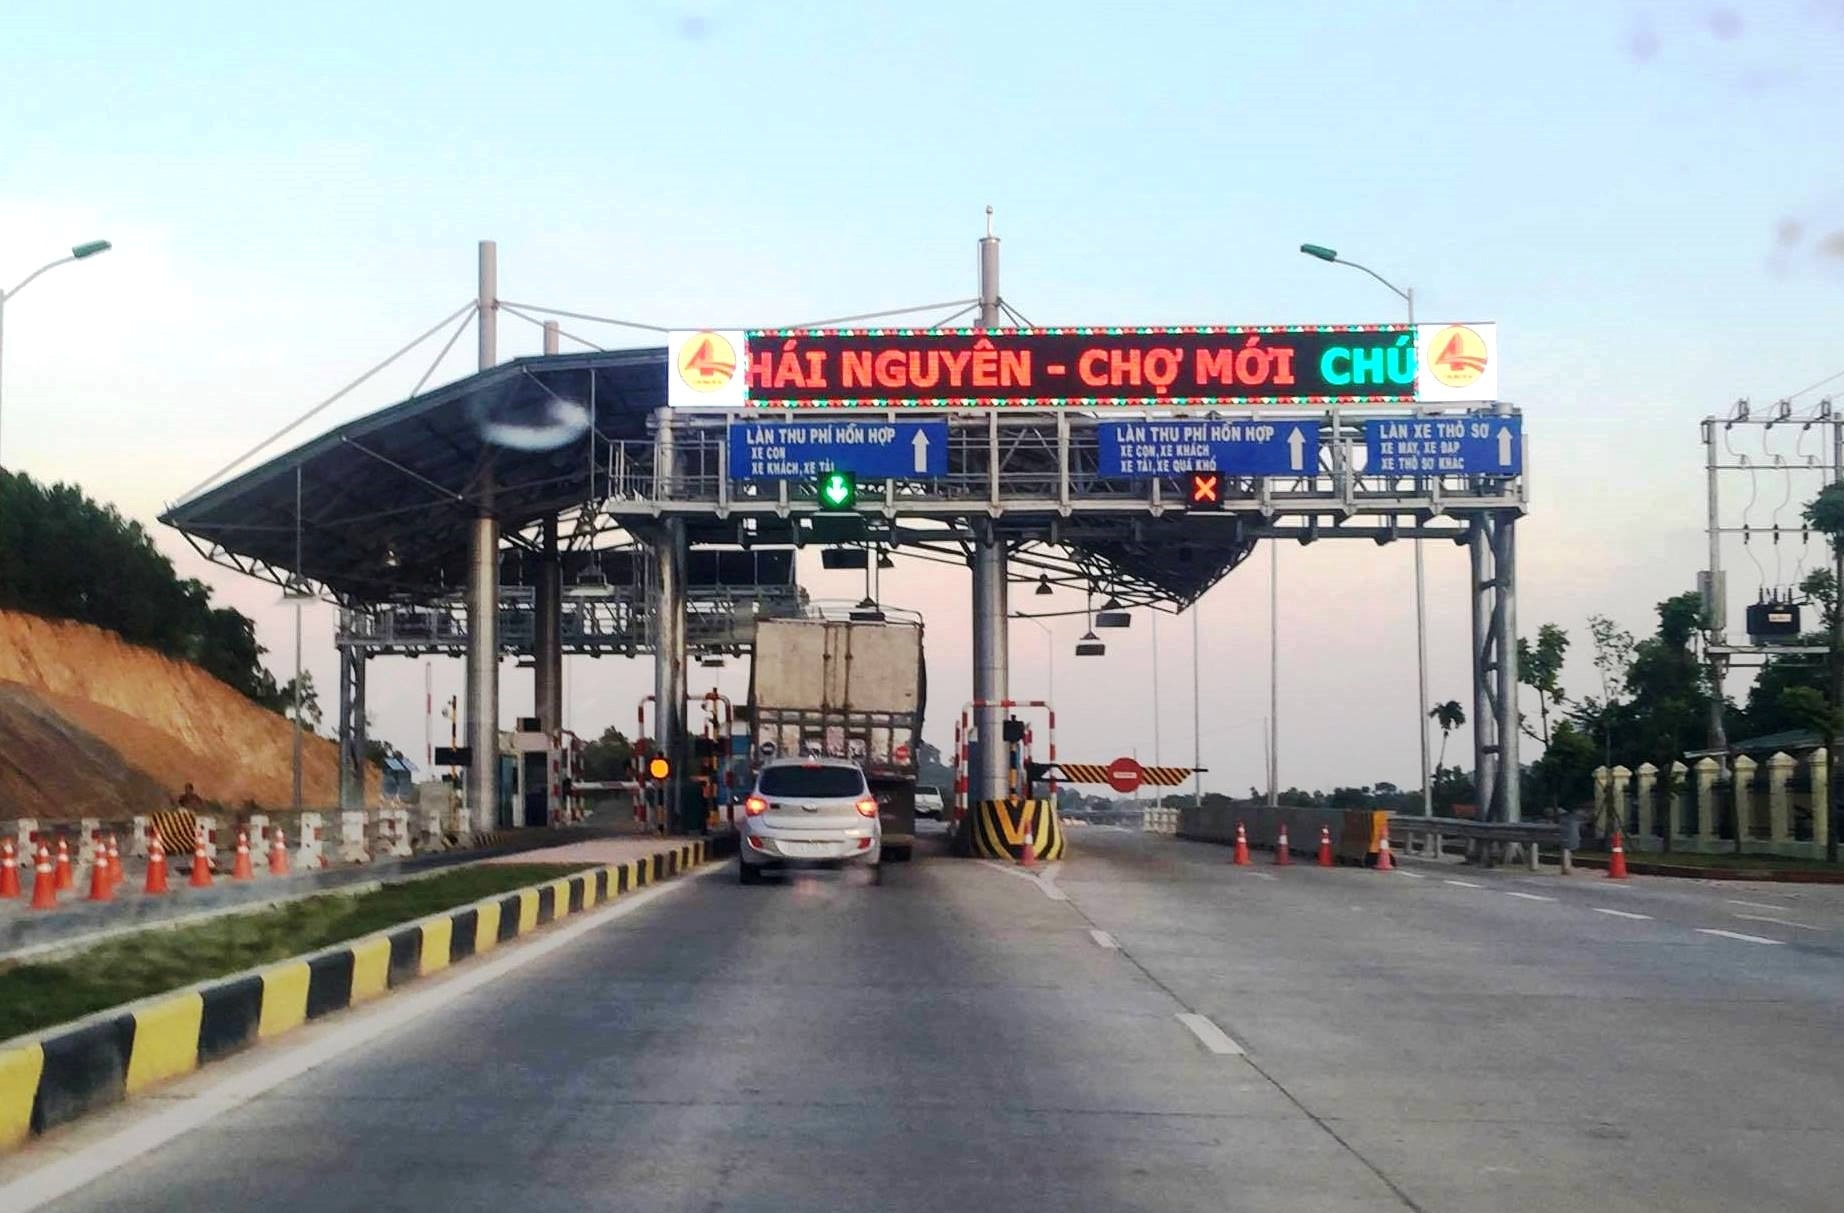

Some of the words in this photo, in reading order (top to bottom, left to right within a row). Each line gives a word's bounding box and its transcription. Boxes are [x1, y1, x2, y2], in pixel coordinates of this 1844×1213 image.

[842, 338, 1032, 387] NGUYÊN
[1079, 348, 1183, 394] CHỢ
[1195, 336, 1294, 386] MỚI
[1320, 335, 1416, 385] CHÚ
[746, 425, 774, 445] LÀN
[778, 428, 806, 444] THU
[810, 424, 833, 444] PHÍ
[868, 426, 896, 446] HỢP
[1116, 424, 1146, 442] LÀN
[1150, 427, 1179, 442] THU
[1184, 423, 1207, 442] PHÍ
[1245, 425, 1275, 444] HỢP
[1380, 421, 1408, 439] LÀN
[1413, 424, 1432, 439] XE
[1471, 423, 1490, 438] SƠ
[751, 447, 764, 460] XE
[766, 447, 786, 459] CON
[1120, 445, 1133, 457] XE
[1381, 441, 1394, 454] XE
[1423, 441, 1437, 454] XE
[751, 462, 764, 475] XE
[1120, 460, 1134, 473] XE
[1381, 457, 1394, 470] XE
